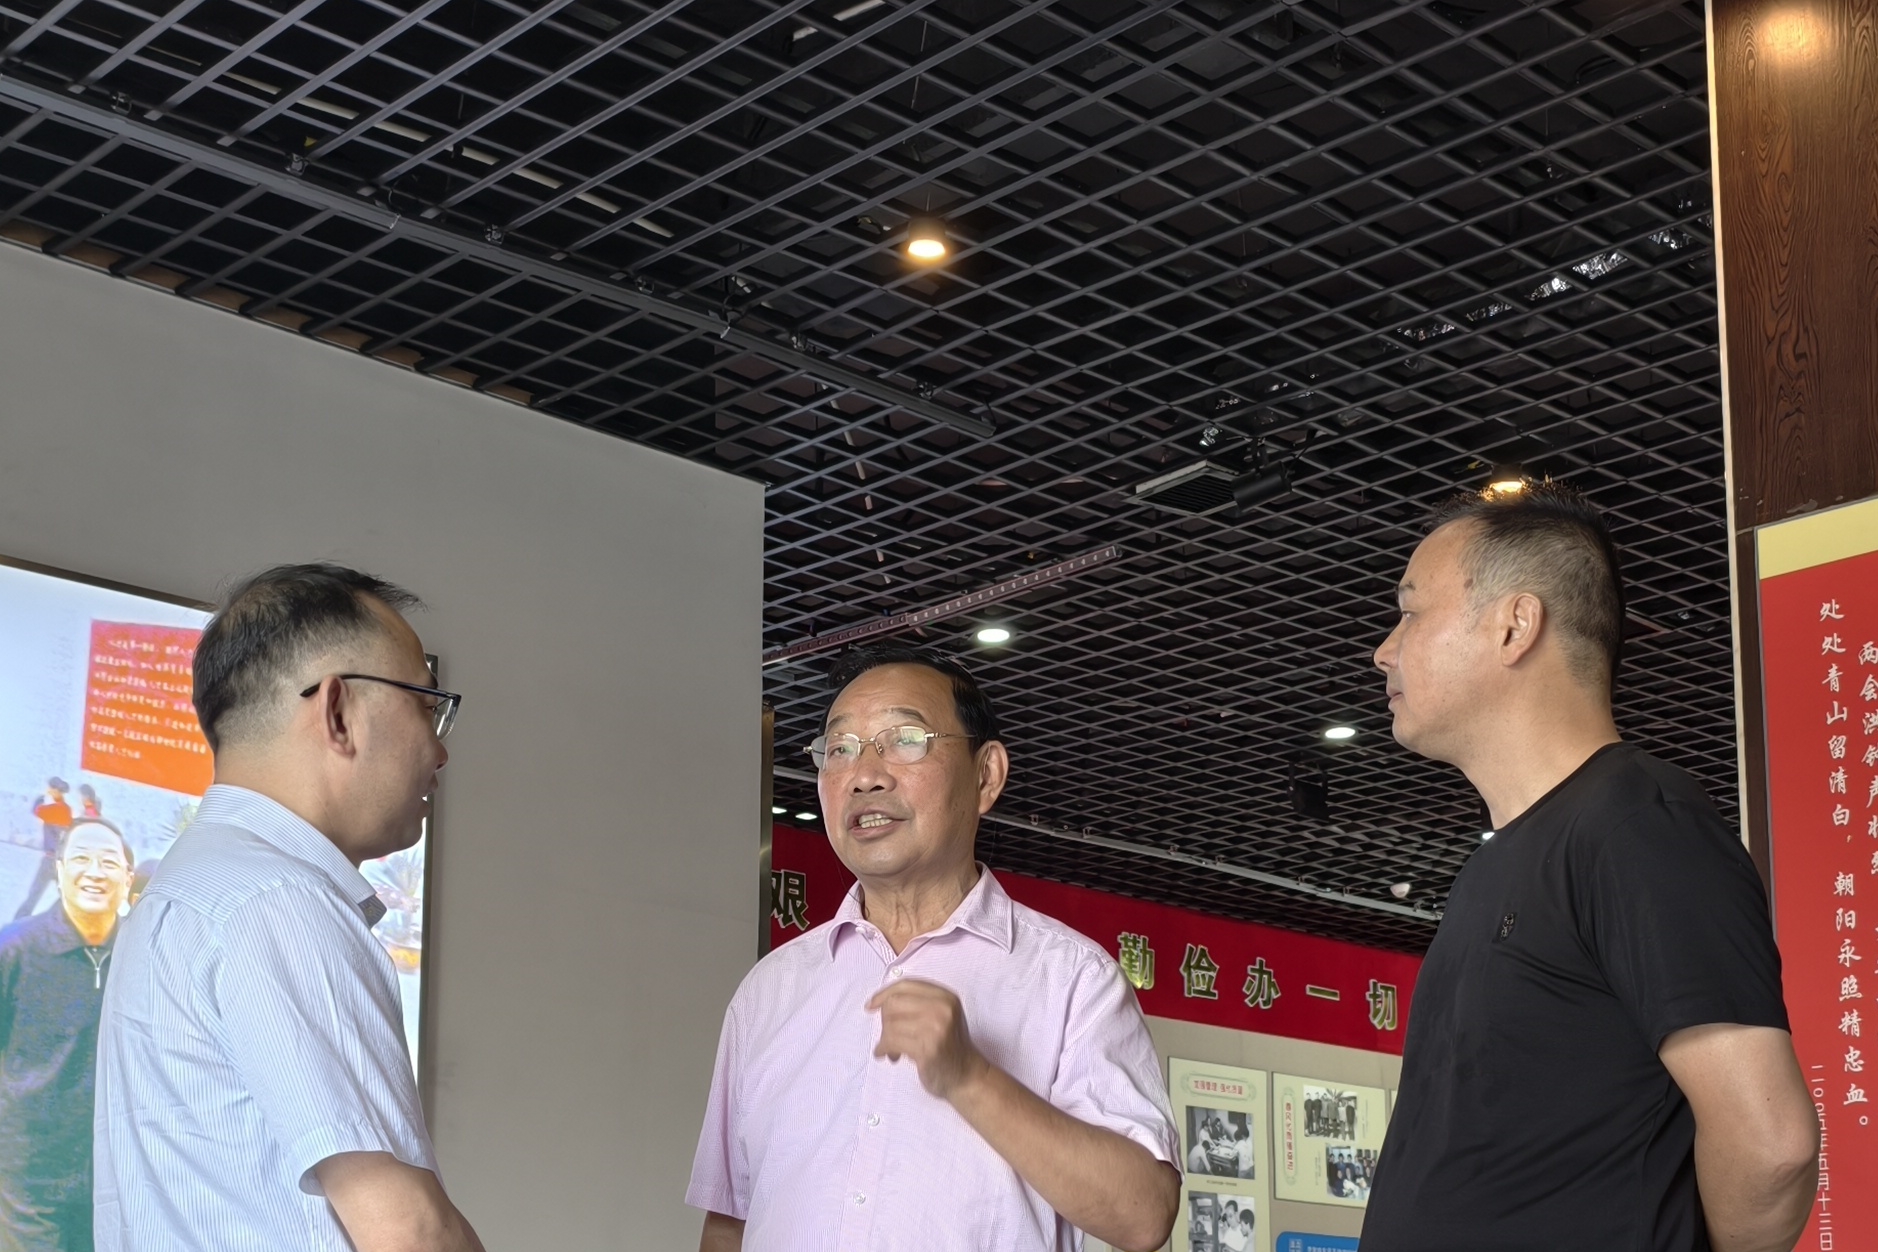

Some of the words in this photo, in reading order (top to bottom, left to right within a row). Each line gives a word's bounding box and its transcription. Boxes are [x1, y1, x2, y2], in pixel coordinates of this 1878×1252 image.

[1117, 931, 1399, 1031] 勤俭办一切
